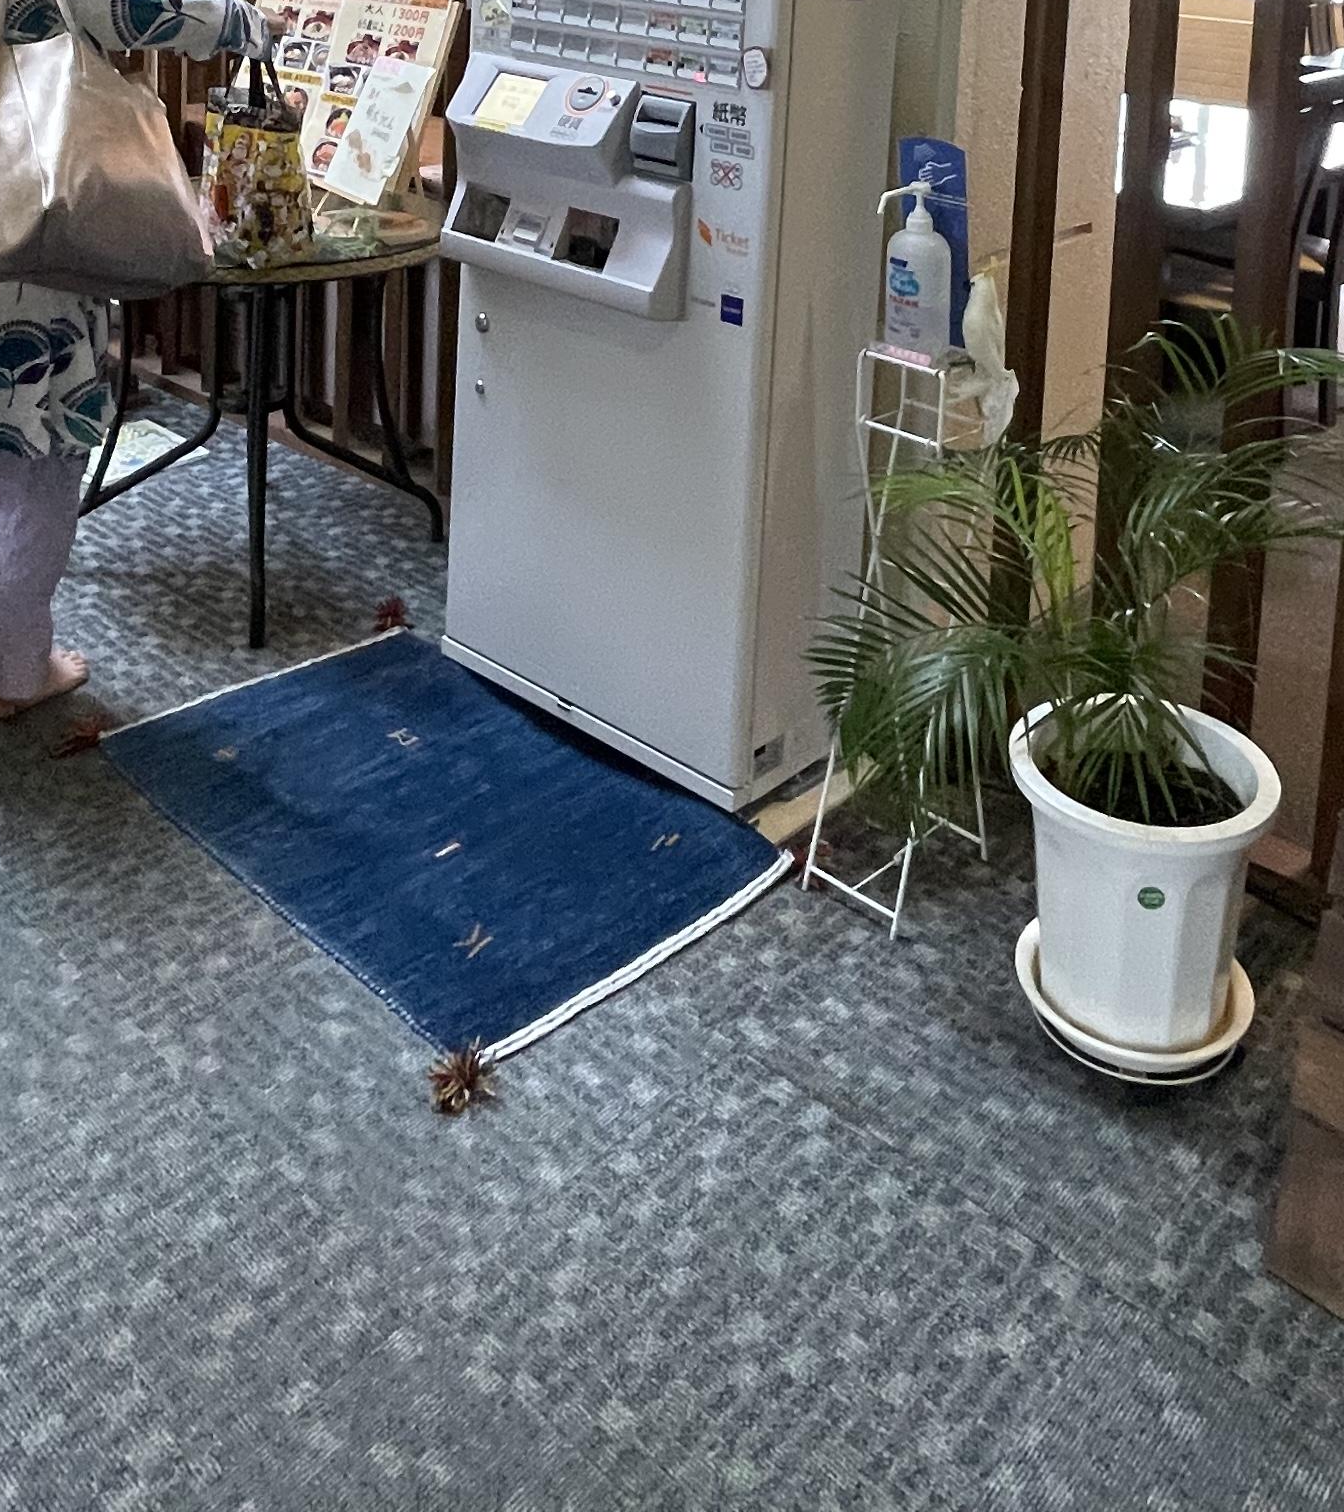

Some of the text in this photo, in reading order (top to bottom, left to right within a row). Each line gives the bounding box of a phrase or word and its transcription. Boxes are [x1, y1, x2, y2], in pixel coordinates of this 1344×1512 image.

[364, 3, 431, 25] 大人 1300円
[388, 23, 426, 40] 1200円
